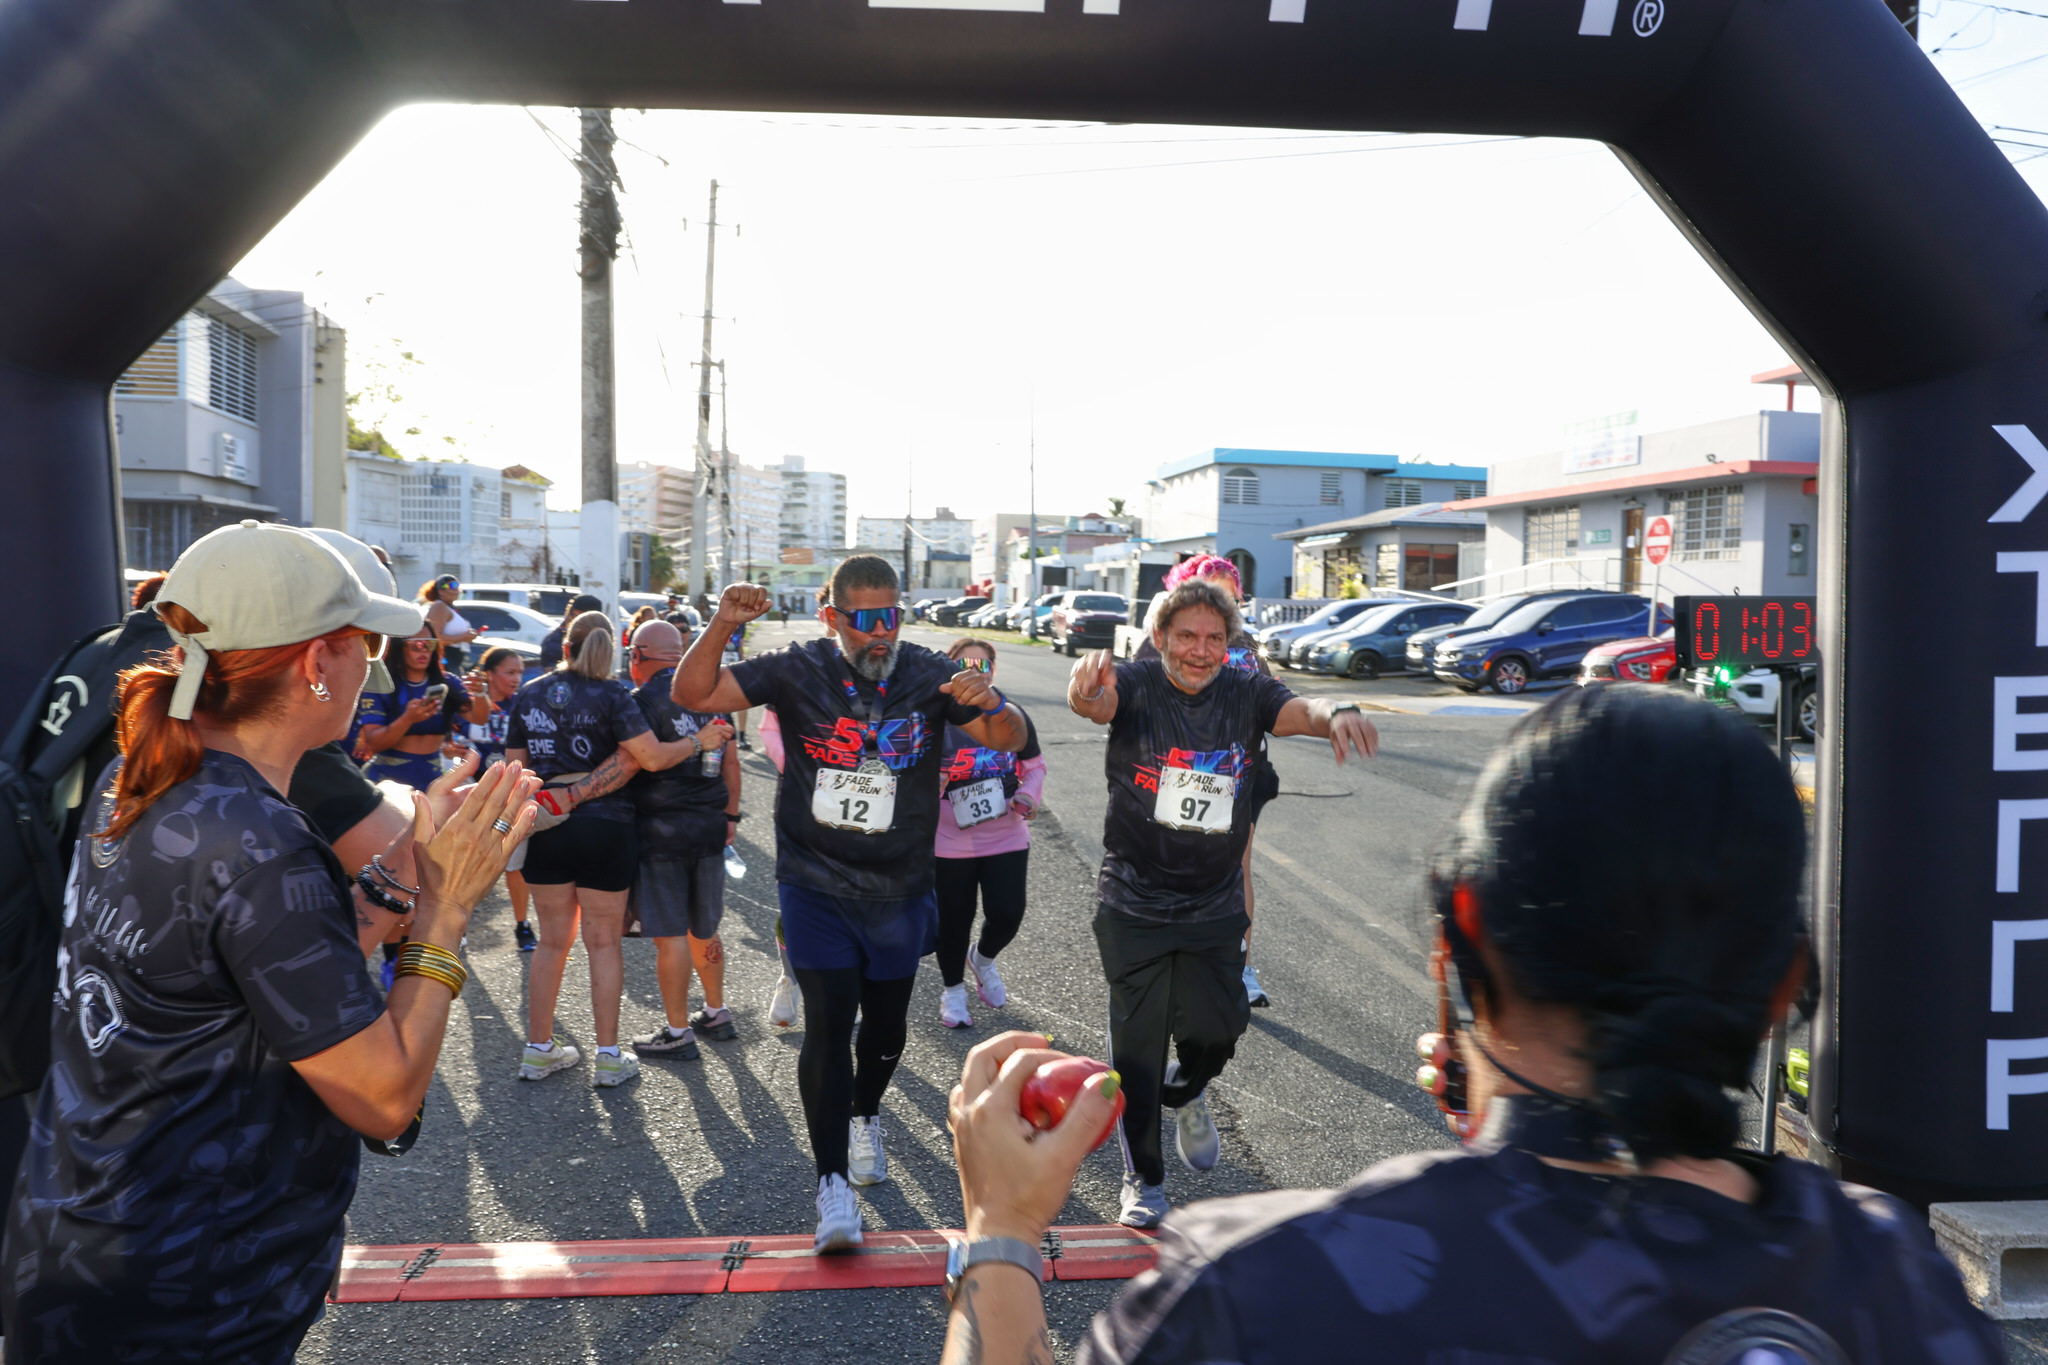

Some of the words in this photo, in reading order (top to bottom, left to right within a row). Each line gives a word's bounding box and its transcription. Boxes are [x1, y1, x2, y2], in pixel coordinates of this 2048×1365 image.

[528, 739, 556, 754] EME
[803, 743, 859, 767] FADE
[948, 747, 1000, 772] 5K
[844, 774, 874, 786] FADE
[1188, 773, 1216, 786] FADE
[857, 785, 882, 795] RUN
[1201, 784, 1223, 795] RUN
[839, 798, 869, 823] 12
[970, 799, 992, 818] 33
[1180, 797, 1211, 822] 97
